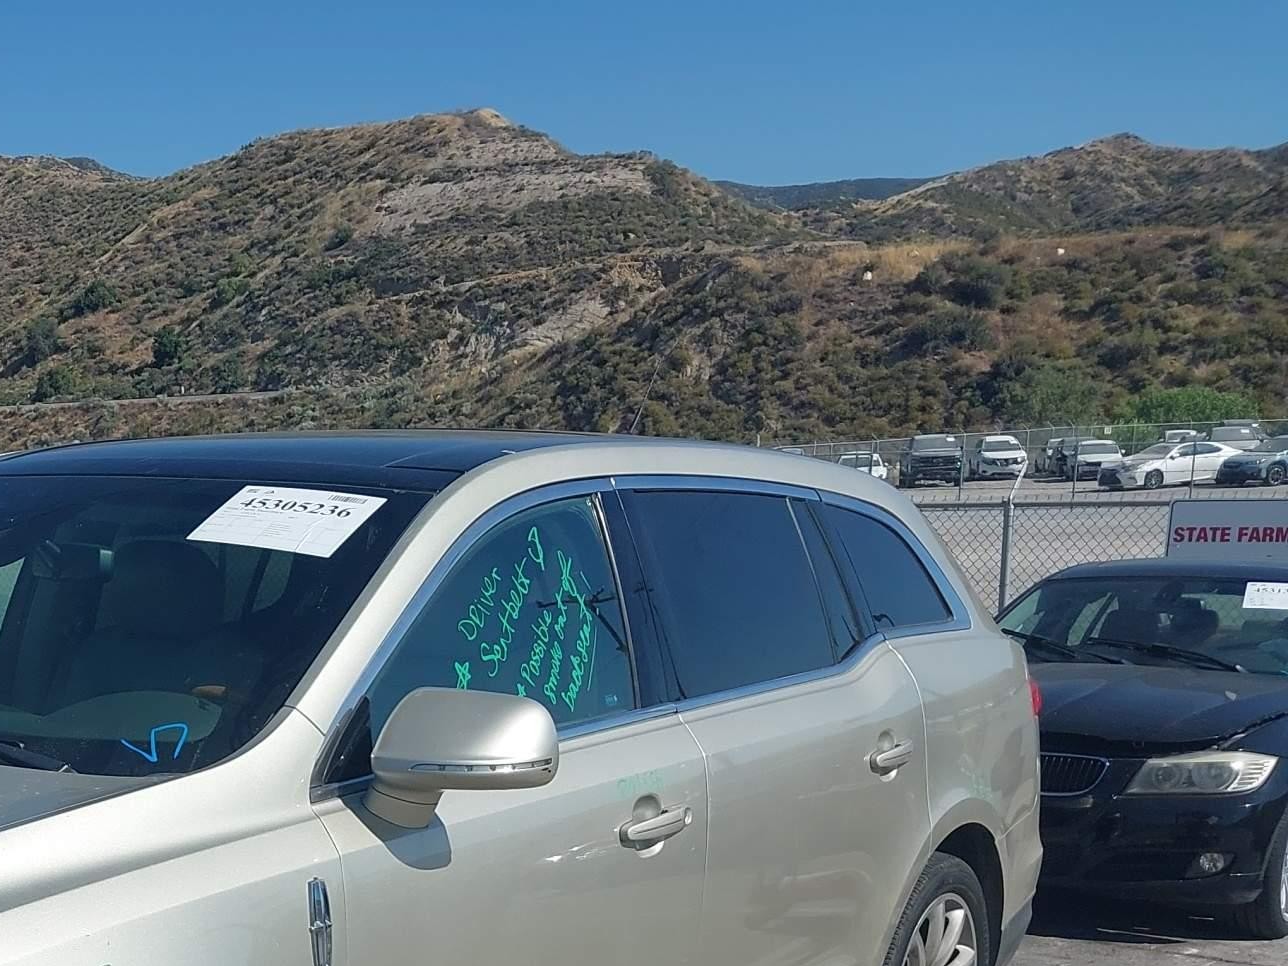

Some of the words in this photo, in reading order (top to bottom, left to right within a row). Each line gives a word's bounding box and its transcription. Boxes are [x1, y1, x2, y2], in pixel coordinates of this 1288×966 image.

[240, 497, 358, 518] 45305236
[1173, 526, 1232, 543] STATE
[1237, 526, 1288, 543] FARM
